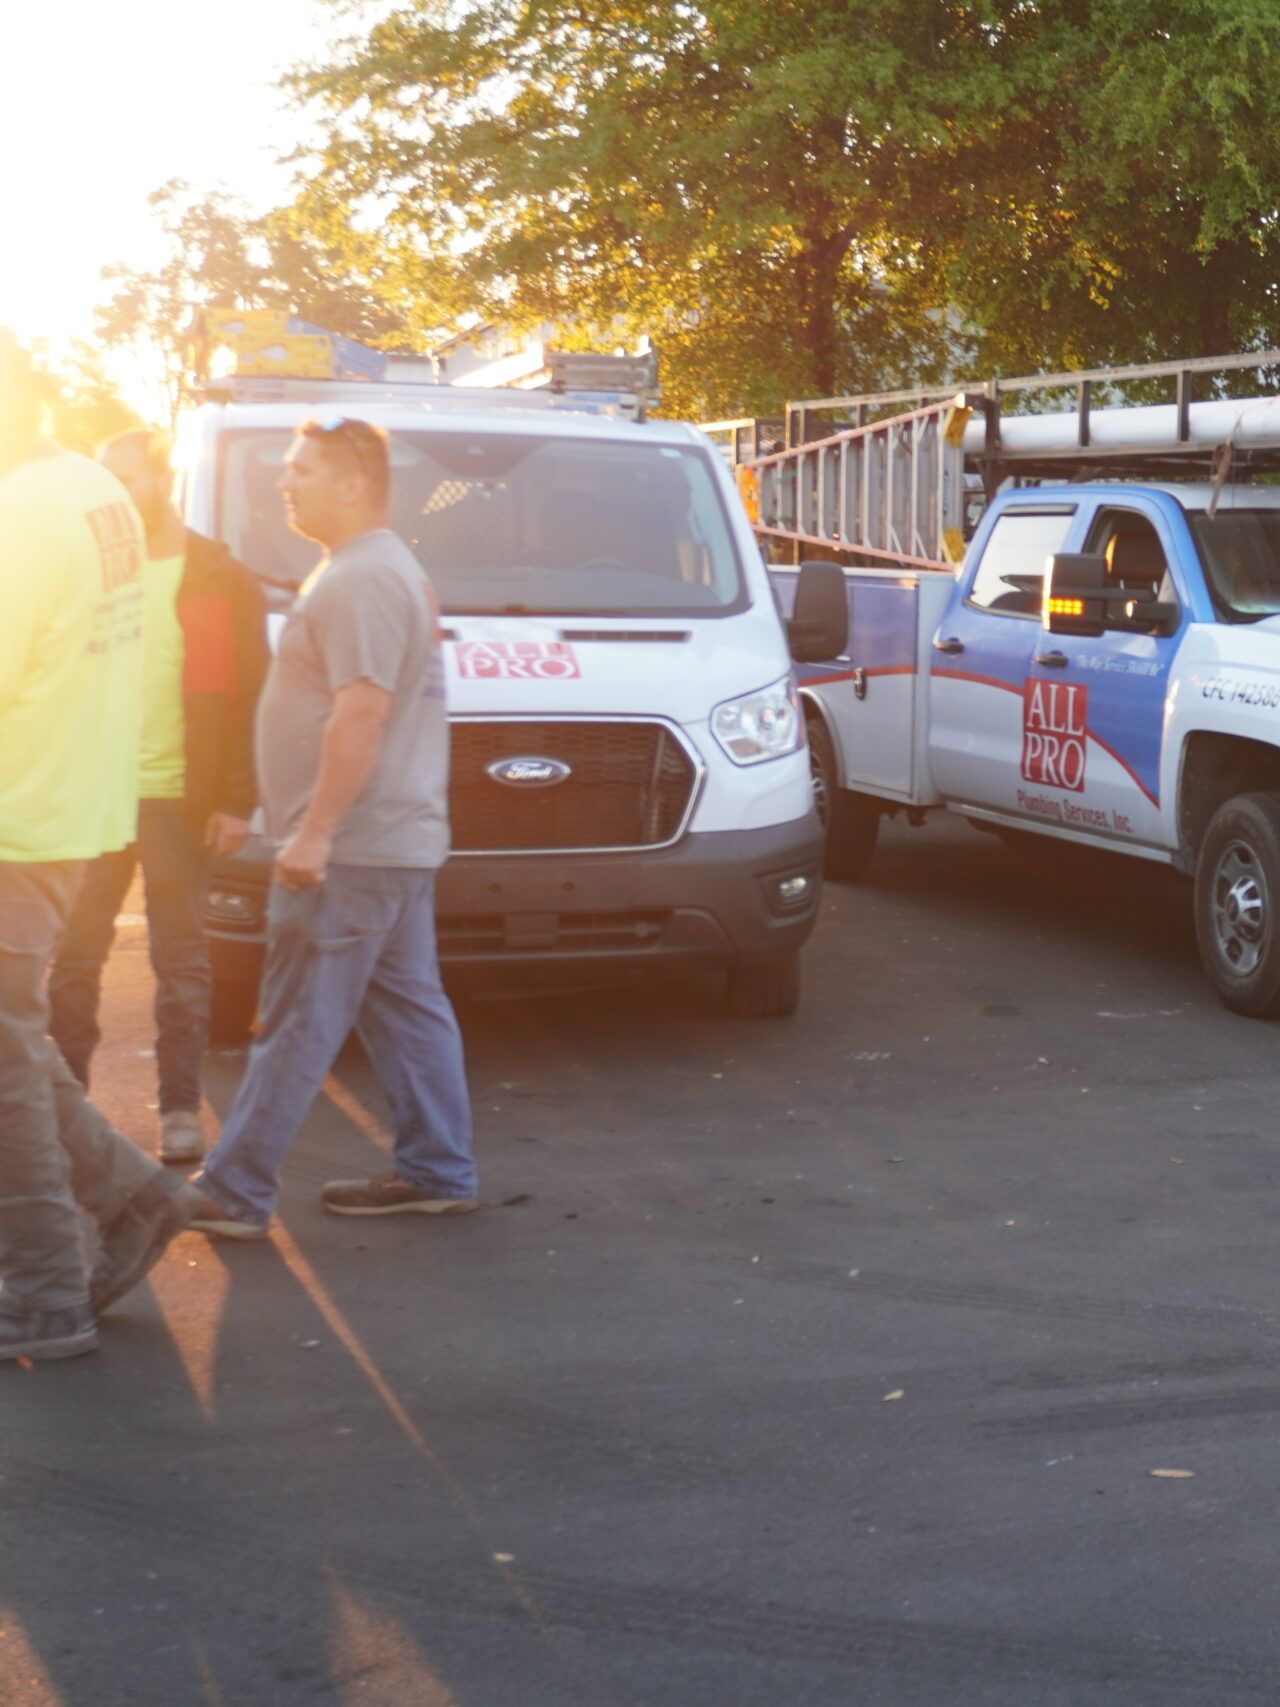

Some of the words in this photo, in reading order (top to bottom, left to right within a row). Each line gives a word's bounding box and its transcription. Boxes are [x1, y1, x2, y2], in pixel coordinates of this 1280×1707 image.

[464, 641, 571, 659] ALL
[464, 659, 576, 678] PRO
[1203, 677, 1232, 700] CFC
[1026, 681, 1084, 736] ALL
[1024, 732, 1084, 788] PRO
[1017, 789, 1062, 821] Plumbing
